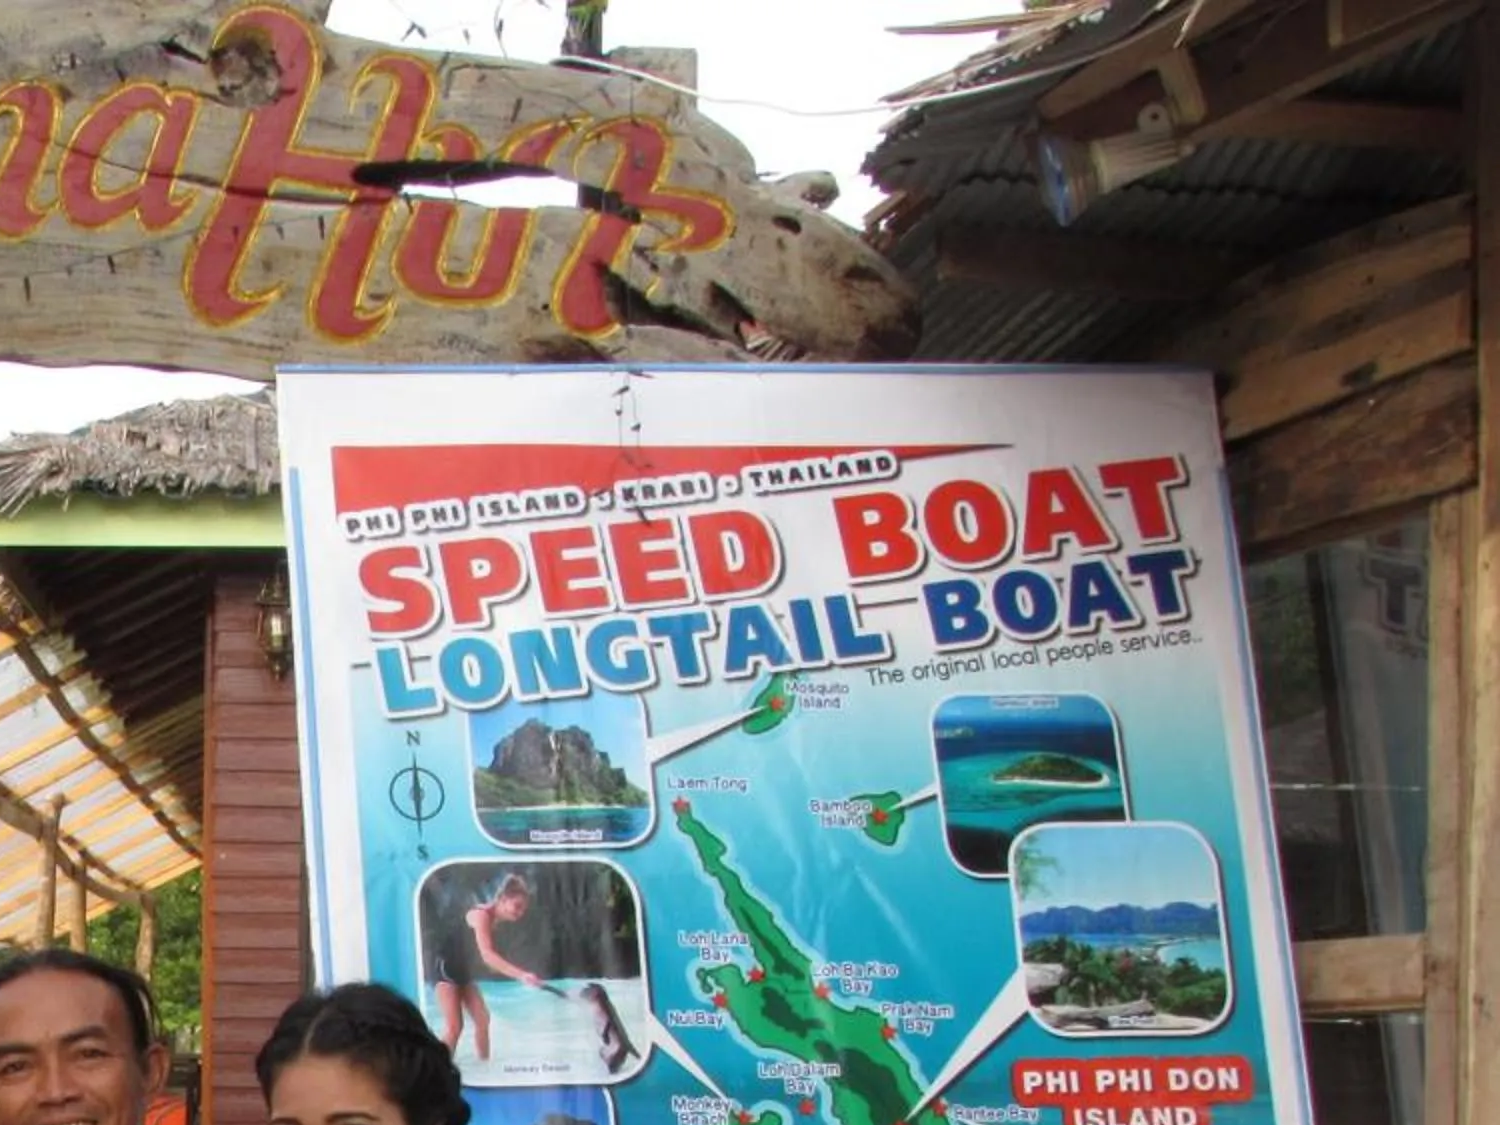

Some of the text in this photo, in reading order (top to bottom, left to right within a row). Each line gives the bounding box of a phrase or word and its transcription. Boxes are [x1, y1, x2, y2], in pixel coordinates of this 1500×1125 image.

[182, 4, 737, 345] Hut
[346, 455, 892, 533] PHI PHI ISLAND KRABI THAILAND
[357, 457, 1179, 634] SPEED BOAT
[376, 549, 1189, 712] LONGTAIL BOAT
[866, 667, 904, 687] The
[912, 656, 985, 685] original
[992, 650, 1039, 671] local
[1046, 638, 1114, 667] people
[784, 682, 850, 698] Mosquito
[799, 696, 841, 710] Island
[406, 730, 421, 746] N
[667, 776, 748, 792] Laem Tong
[809, 799, 872, 814] Bamboo
[821, 814, 865, 828] Island
[417, 844, 429, 860] S
[701, 948, 730, 963] Bay
[843, 979, 871, 994] Bay
[696, 1012, 724, 1028] Bay
[904, 1020, 933, 1035] Bay
[786, 1079, 816, 1094] Bay
[1022, 1067, 1240, 1093] PHI PHI DON
[672, 1098, 731, 1115] Monkey
[1008, 1106, 1038, 1123] Bay
